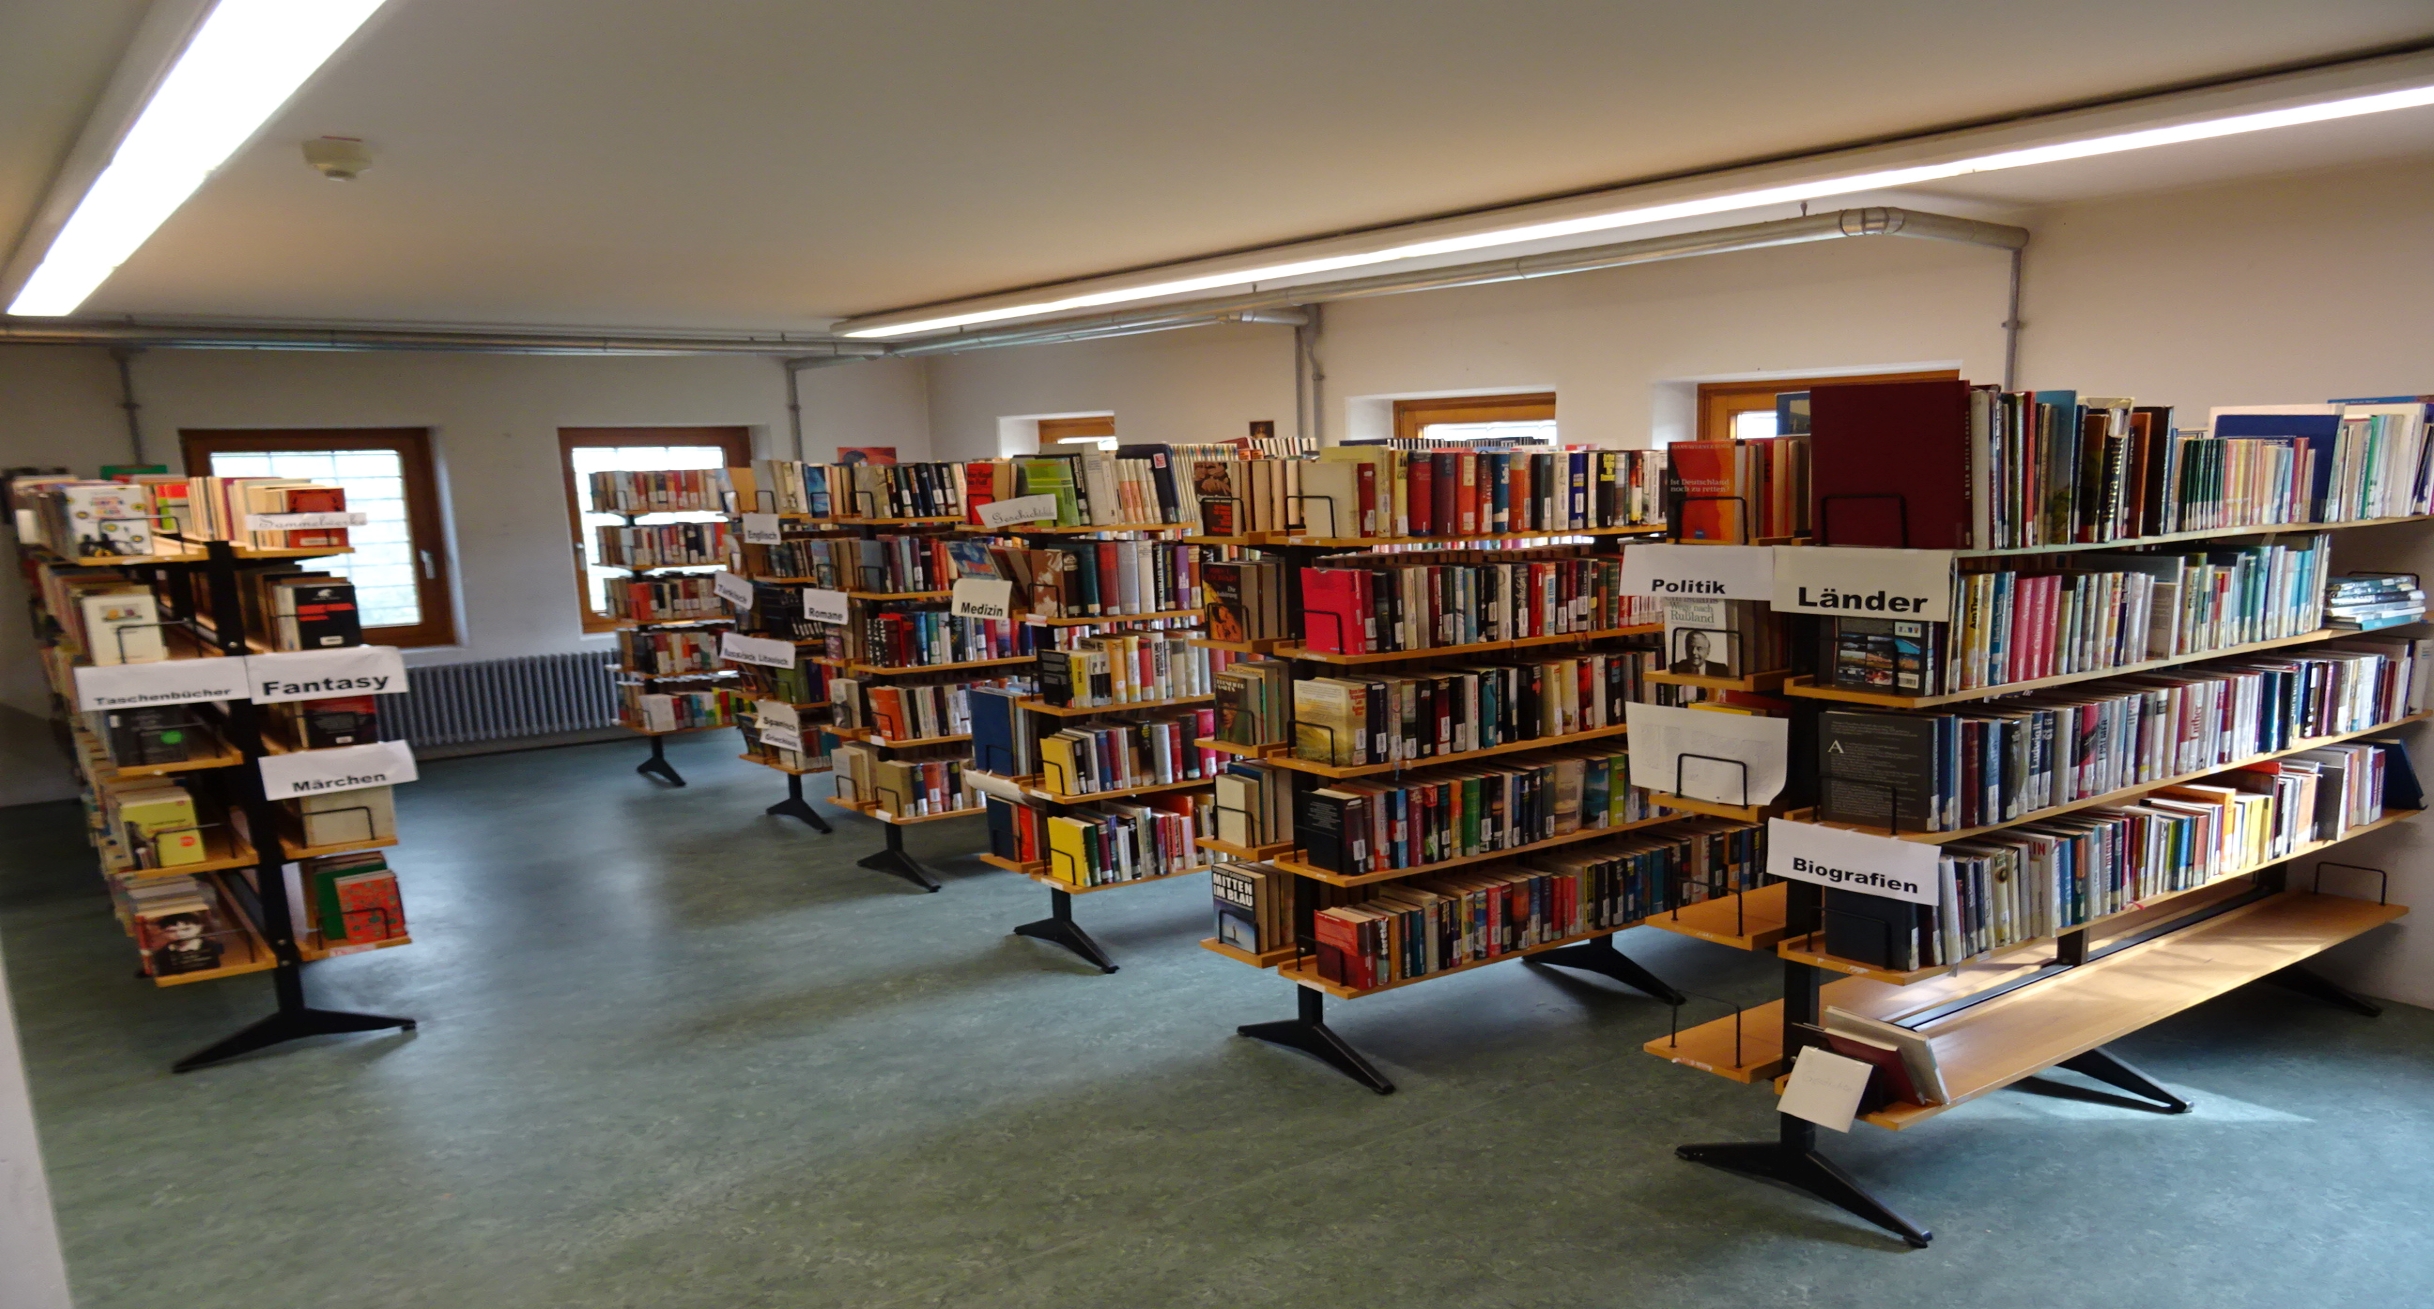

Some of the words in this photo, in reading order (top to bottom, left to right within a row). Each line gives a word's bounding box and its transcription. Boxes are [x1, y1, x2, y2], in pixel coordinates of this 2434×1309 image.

[2101, 480, 2119, 522] Terra
[747, 530, 778, 541] Englisch
[1651, 579, 1726, 594] Politik
[2036, 581, 2047, 606] Japan
[960, 602, 1004, 617] Medizin
[1670, 601, 1692, 612] Wege
[1694, 604, 1714, 613] nach
[1798, 586, 1928, 614] Länder
[808, 607, 843, 621] Romane
[1670, 610, 1715, 623] Rußland
[2035, 606, 2043, 624] und
[2033, 624, 2043, 650] China
[262, 673, 391, 697] Fantasy
[95, 686, 232, 706] Taschenbücher
[763, 716, 797, 733] Spanisch
[2189, 705, 2202, 741] Luther
[1827, 739, 1845, 754] A
[292, 771, 387, 793] Märchen
[1213, 873, 1253, 896] MITTEN
[1792, 857, 1918, 894] Biografien
[1213, 884, 1226, 899] IM
[1226, 889, 1254, 907] BLAU
